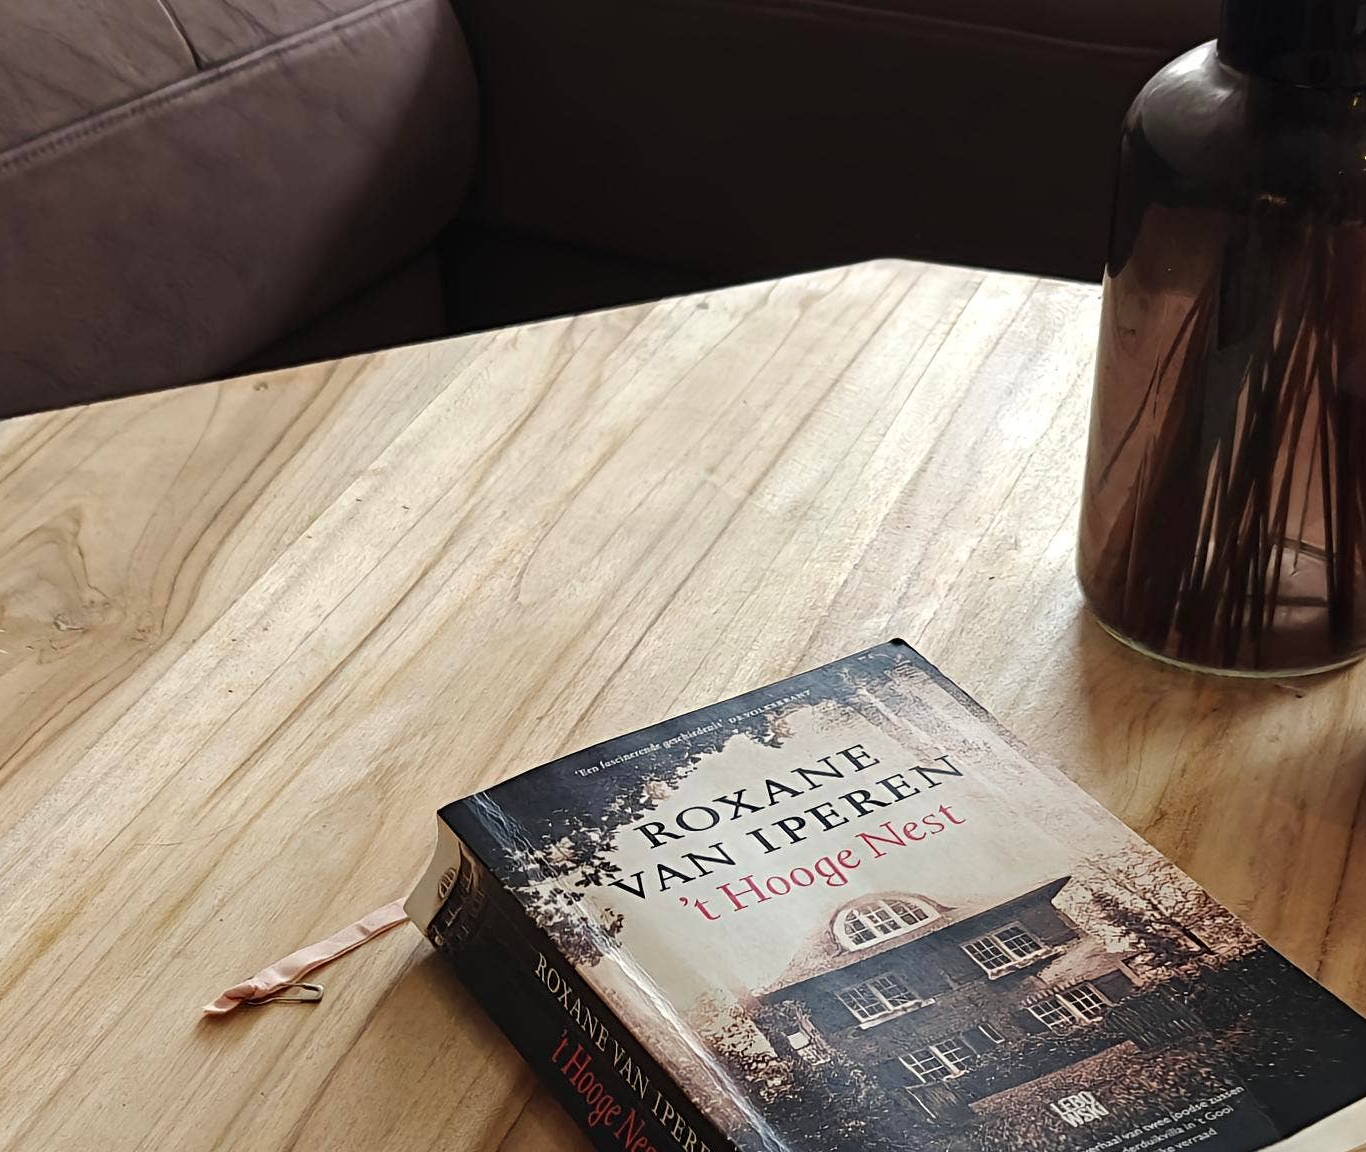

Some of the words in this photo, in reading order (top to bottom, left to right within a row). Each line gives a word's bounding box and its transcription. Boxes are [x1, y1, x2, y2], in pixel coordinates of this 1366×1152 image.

[608, 842, 737, 902] VAN
[746, 754, 964, 854] IPEREN
[633, 743, 881, 849] ROXANE
[716, 845, 861, 913] Hooge
[855, 802, 967, 860] Nest
[535, 953, 609, 1055] ROXANE
[612, 1041, 651, 1100] VAN
[561, 1044, 622, 1128] Hooge
[1050, 1091, 1094, 1115] LEBO
[1061, 1101, 1110, 1127] WSKI
[1121, 1127, 1143, 1140] van
[1142, 1117, 1172, 1132] twee
[1209, 1086, 1245, 1105] zussen
[1175, 1127, 1218, 1149] verraad
[1182, 1121, 1196, 1131] in
